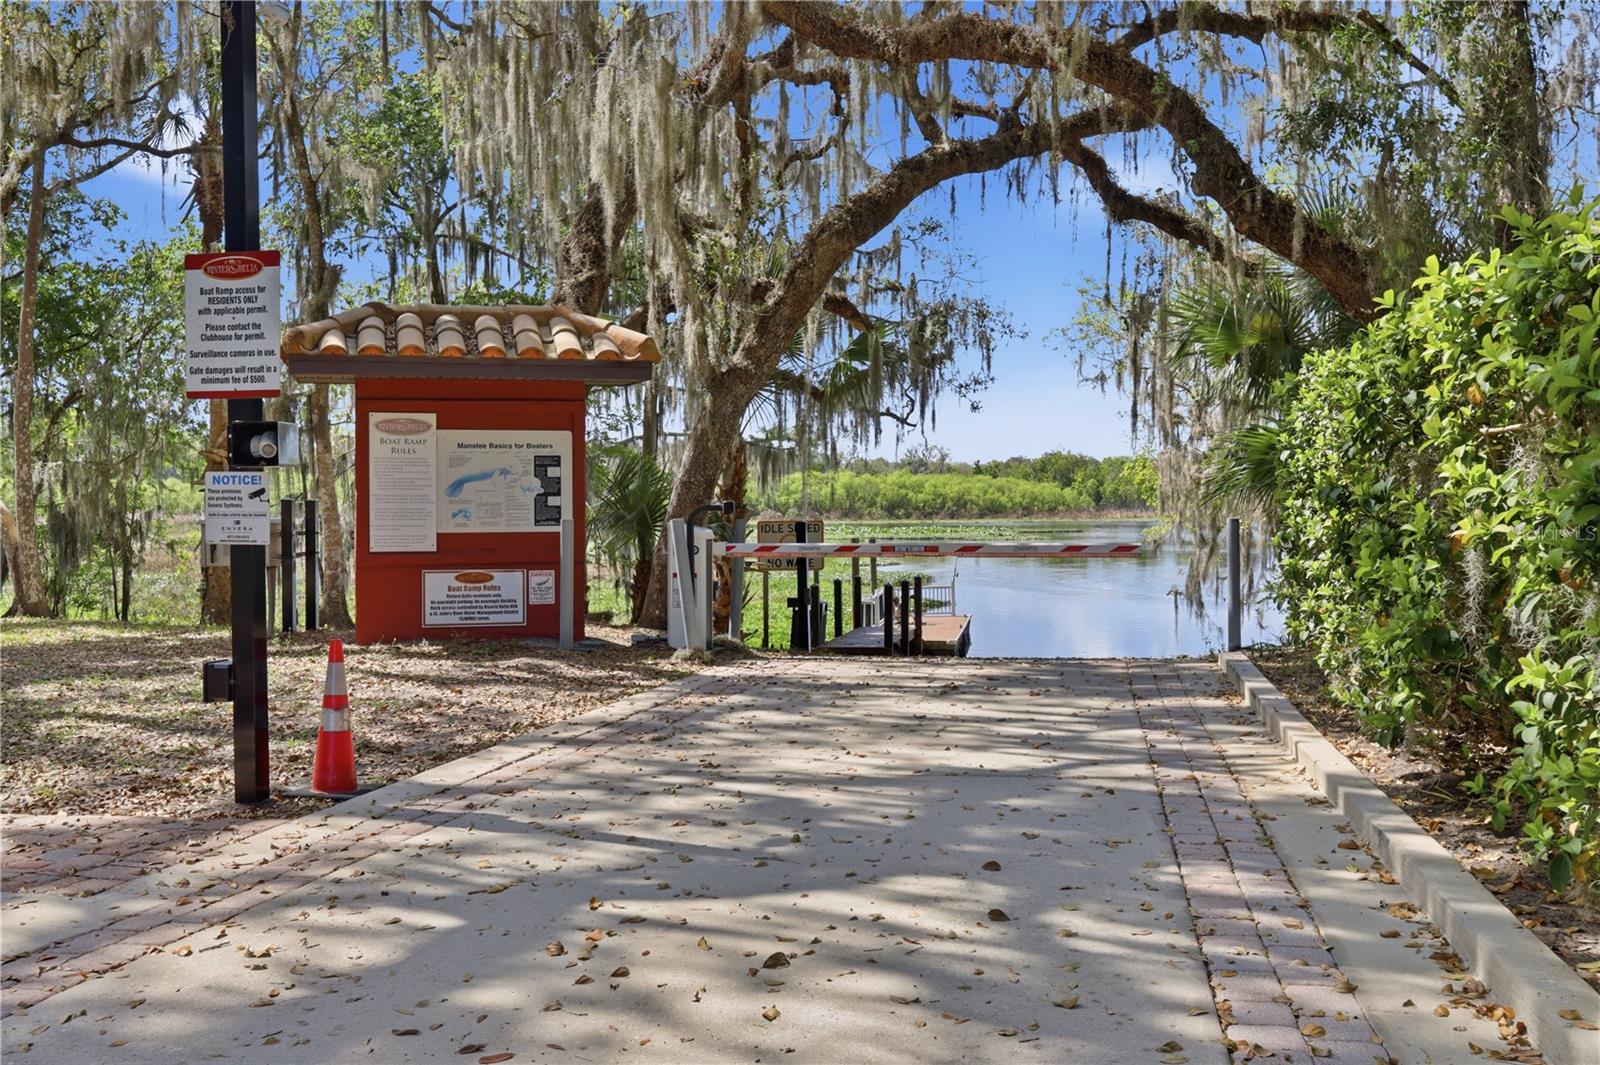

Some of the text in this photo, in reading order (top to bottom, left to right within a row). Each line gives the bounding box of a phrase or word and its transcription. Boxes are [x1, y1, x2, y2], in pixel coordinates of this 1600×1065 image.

[200, 287, 214, 295] Boat
[216, 287, 233, 296] Ramp
[257, 285, 266, 293] for
[208, 295, 258, 305] RESIDENTS ONLY
[198, 305, 268, 316] with applicable permit.
[205, 322, 262, 332] Please contact the
[200, 333, 233, 341] Clubhouse
[244, 332, 266, 341] permit.
[189, 350, 228, 358] Surveillance
[256, 348, 263, 356] in
[189, 366, 204, 375] Gate
[205, 366, 233, 376] damages
[234, 365, 246, 373] will
[247, 365, 265, 373] result
[265, 364, 272, 373] in
[200, 375, 266, 384] minimum fee of $500.
[212, 475, 262, 485] NOTICE!
[760, 524, 821, 533] IDLE SED
[768, 558, 782, 568] NO
